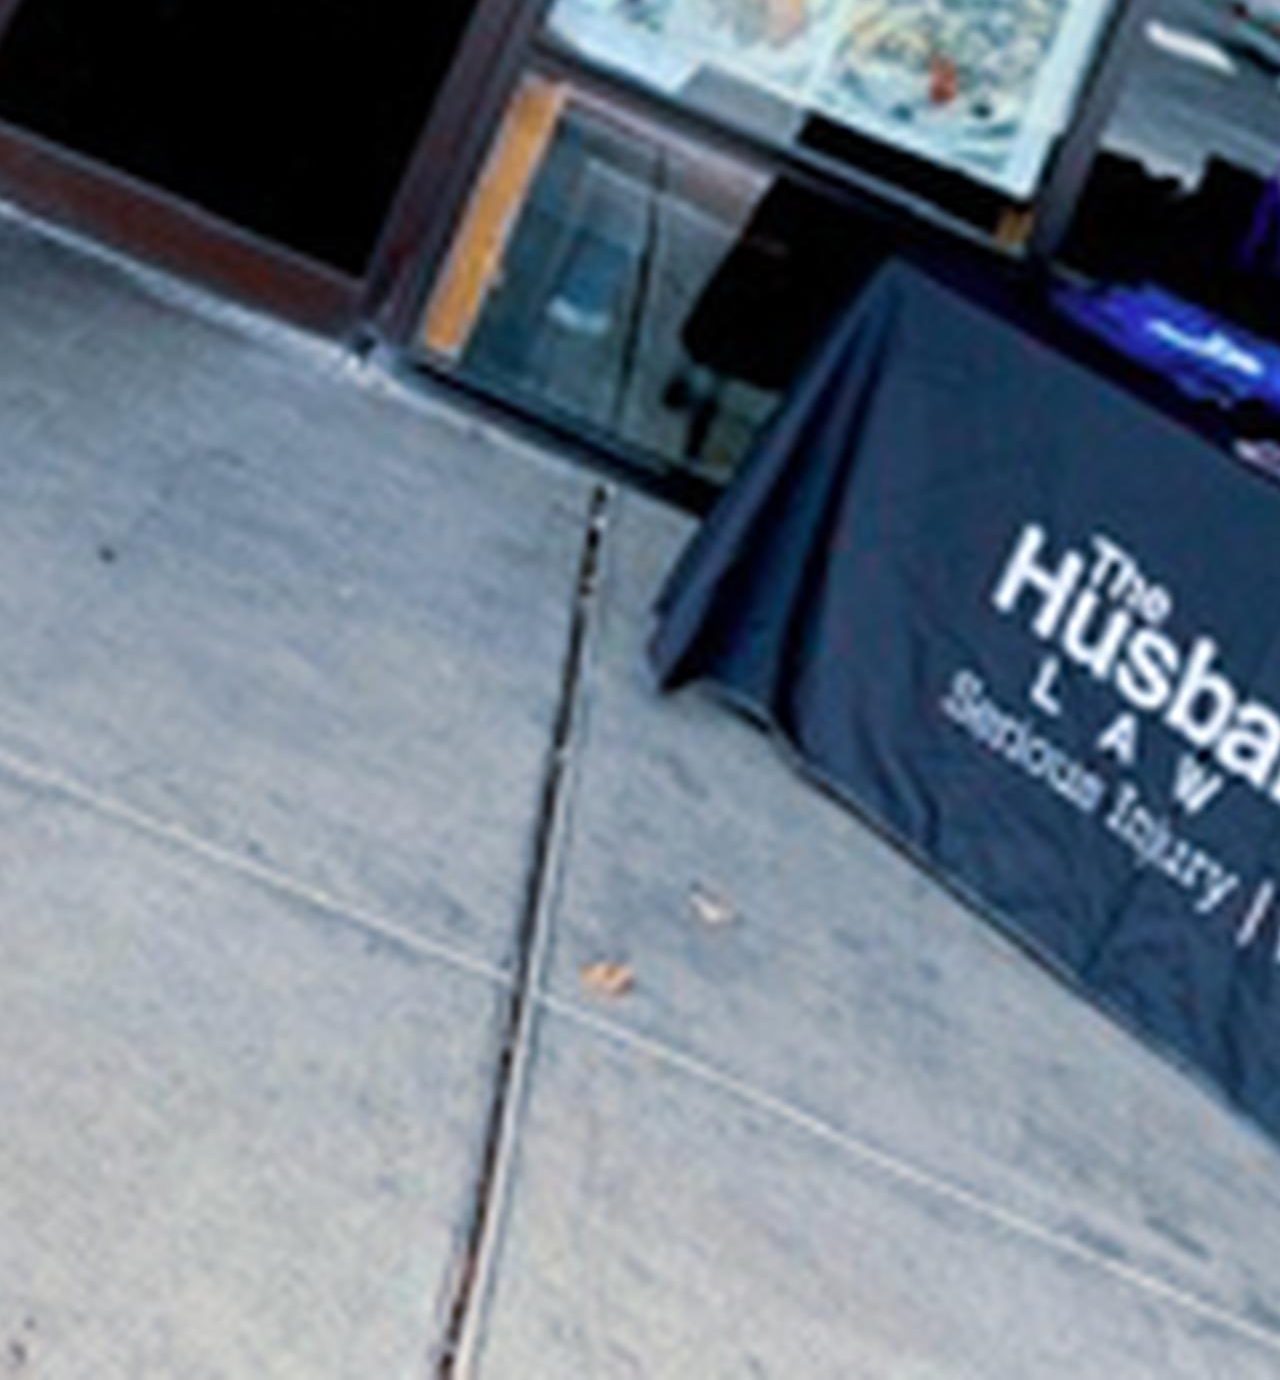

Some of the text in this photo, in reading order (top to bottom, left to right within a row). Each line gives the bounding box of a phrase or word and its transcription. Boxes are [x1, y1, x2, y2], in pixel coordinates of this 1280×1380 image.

[1089, 535, 1173, 625] The
[938, 668, 1106, 815] Serious
[1104, 776, 1240, 917] Injury
[1029, 657, 1224, 814] LAW
